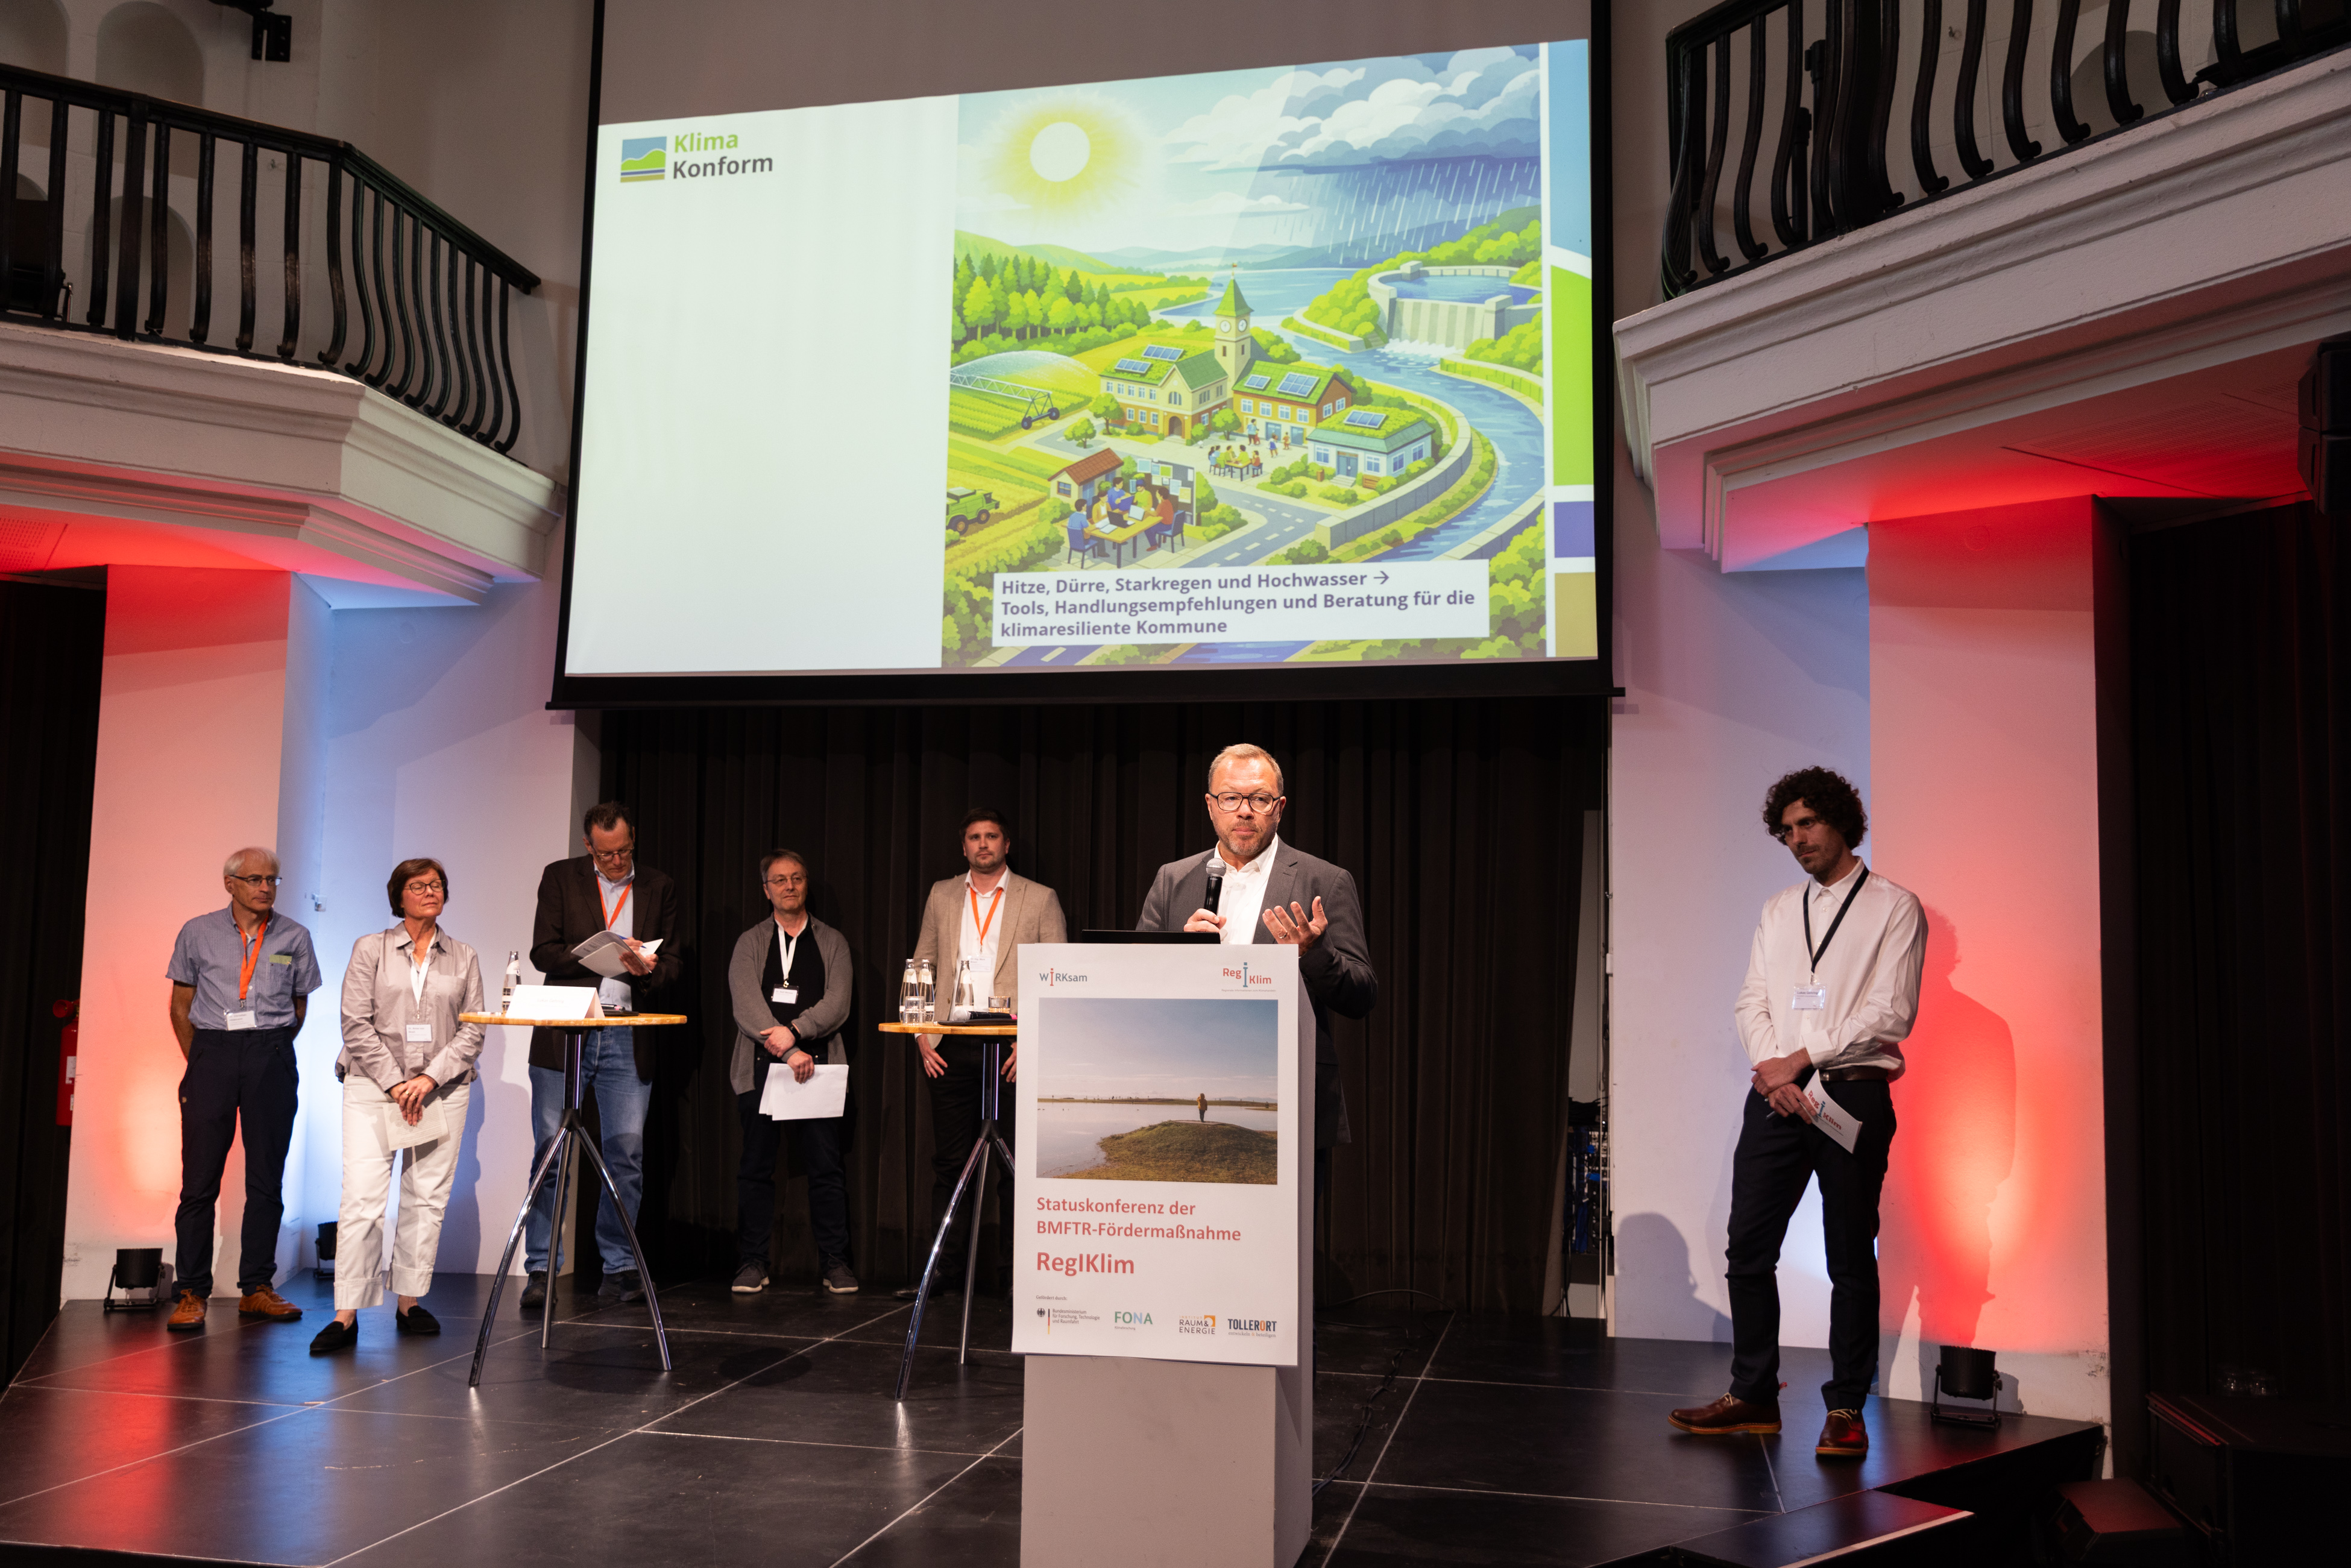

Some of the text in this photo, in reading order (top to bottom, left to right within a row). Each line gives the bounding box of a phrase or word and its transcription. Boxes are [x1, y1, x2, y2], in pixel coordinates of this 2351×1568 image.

[675, 132, 738, 153] Klima
[673, 156, 773, 179] Konform
[1002, 573, 1367, 595] Hitze, Dürre, Starkregen und Hochwasser
[1001, 590, 1474, 617] Tools, Handlungsempfehlungen und Beratung für die
[1001, 620, 1227, 637] klimaresiliente Kommune
[1037, 1197, 1195, 1215] Statuskonferenz der
[1037, 1221, 1241, 1241] BMFTR-Fördermaßnahme
[1115, 1311, 1153, 1324] FONA
[1227, 1318, 1277, 1332] TOLLERORT
[1179, 1326, 1215, 1335] ENERGIE
